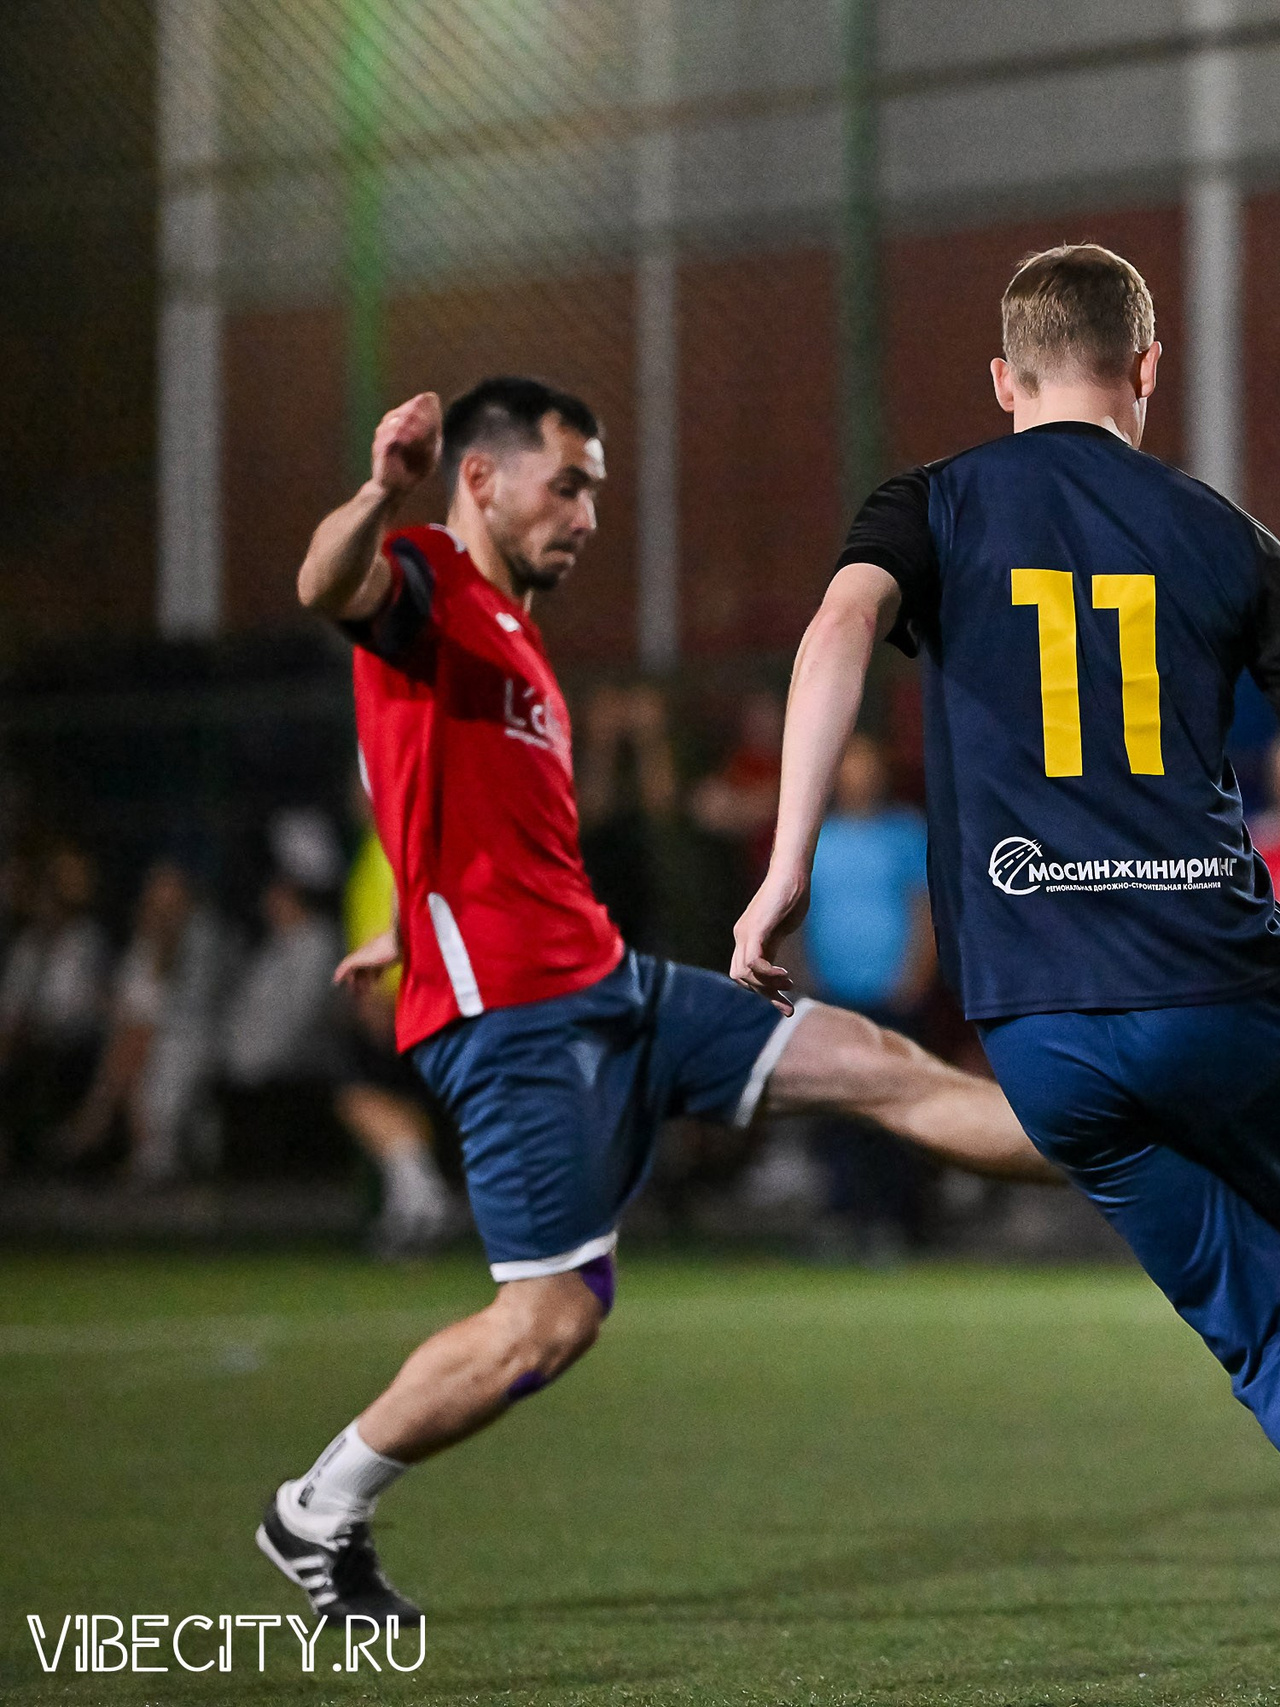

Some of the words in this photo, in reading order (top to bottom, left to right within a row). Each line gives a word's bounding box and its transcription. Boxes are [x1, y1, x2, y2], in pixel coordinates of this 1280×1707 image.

[1010, 568, 1165, 777] 11
[1093, 882, 1182, 892] ДОРОЖНО-СТРОИТЕЛЬНАЯ
[1183, 881, 1221, 891] КОМПАНИЯ
